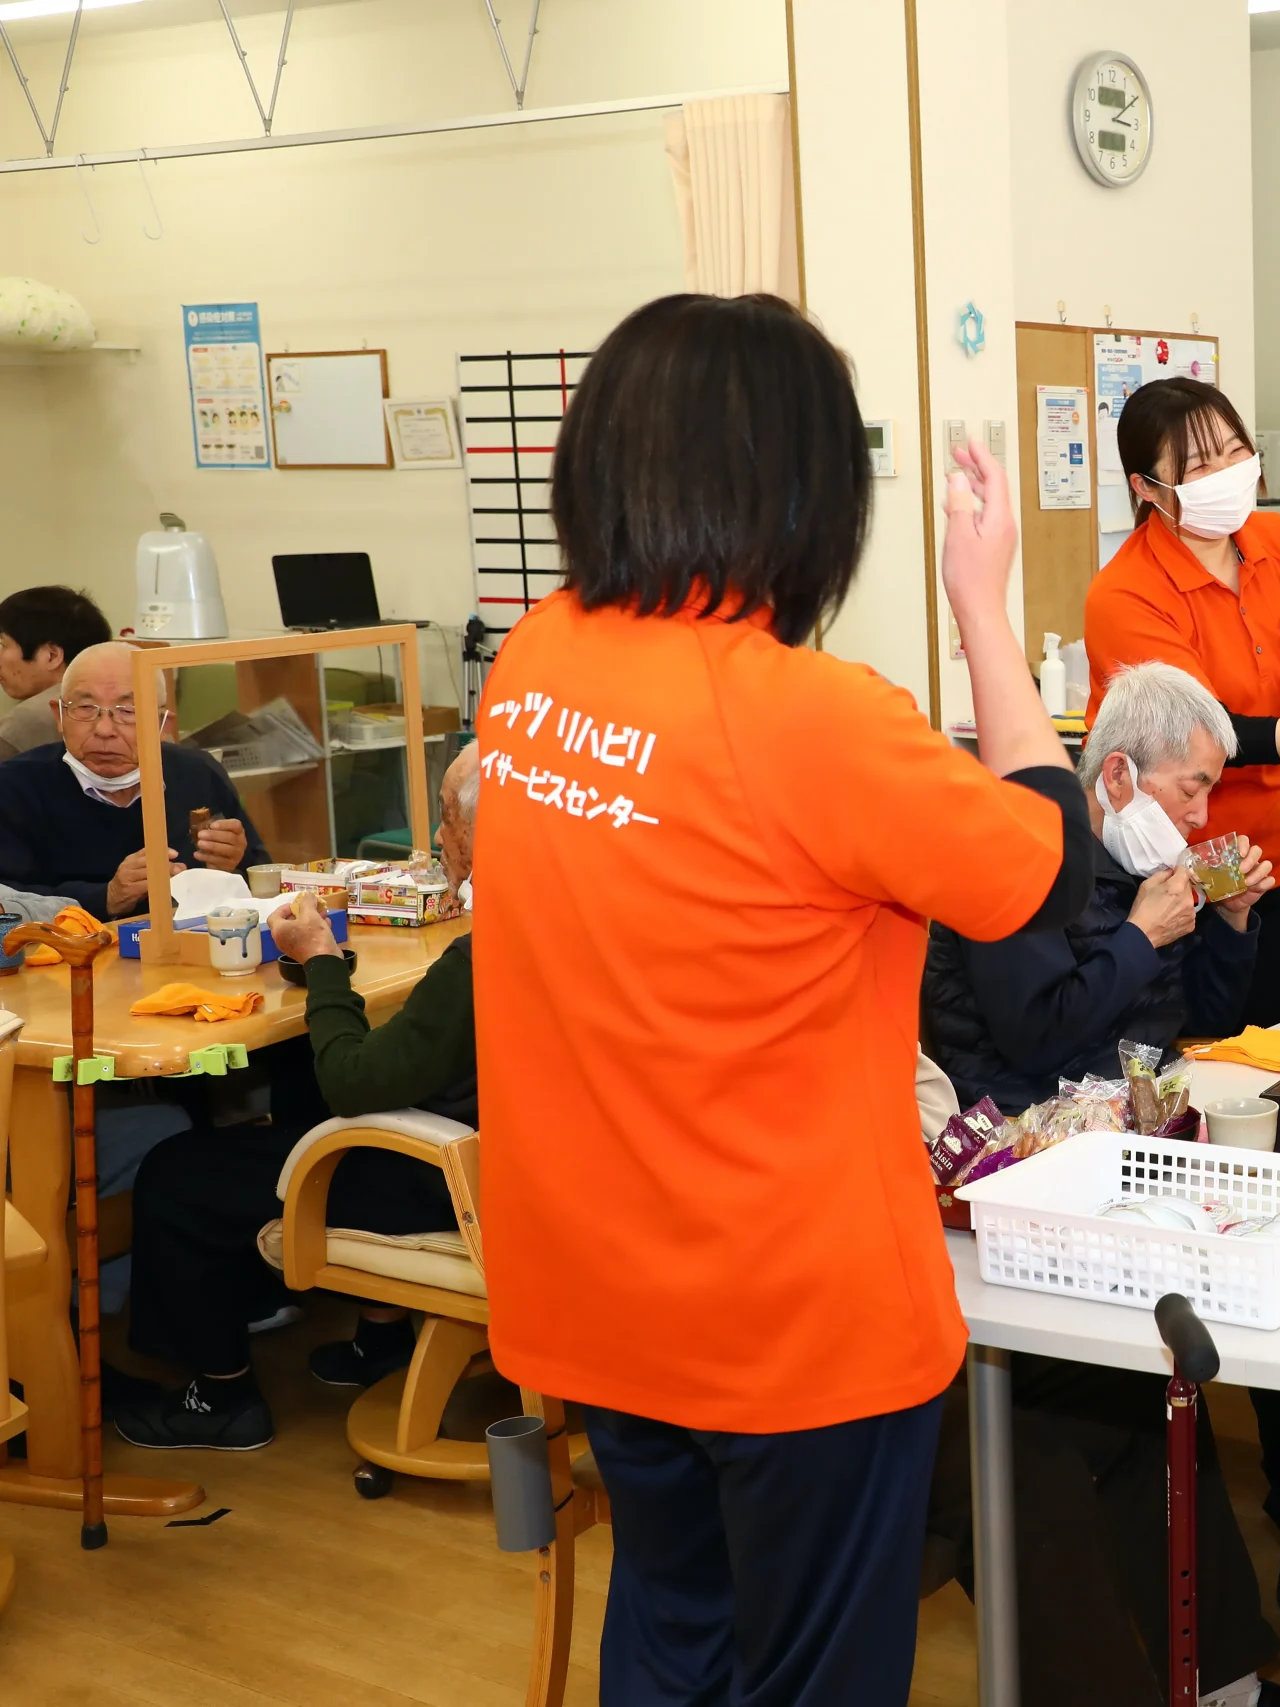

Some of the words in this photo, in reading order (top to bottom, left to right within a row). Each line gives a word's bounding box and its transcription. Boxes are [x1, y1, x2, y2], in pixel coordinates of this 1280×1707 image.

[1096, 70, 1104, 85] 11
[1108, 69, 1117, 84] 12
[1123, 78, 1127, 89] 1
[1087, 88, 1096, 101] 10
[1130, 95, 1137, 108] 2
[1084, 109, 1091, 122] 9
[1133, 118, 1139, 131] 3
[1089, 131, 1095, 144] 8
[1129, 139, 1135, 152] 4
[1098, 150, 1104, 163] 7
[1109, 156, 1116, 170] 6
[1121, 154, 1127, 168] 5
[556, 707, 657, 775] リハビリ
[481, 748, 659, 829] イサービスセンター
[934, 1150, 954, 1171] aisin
